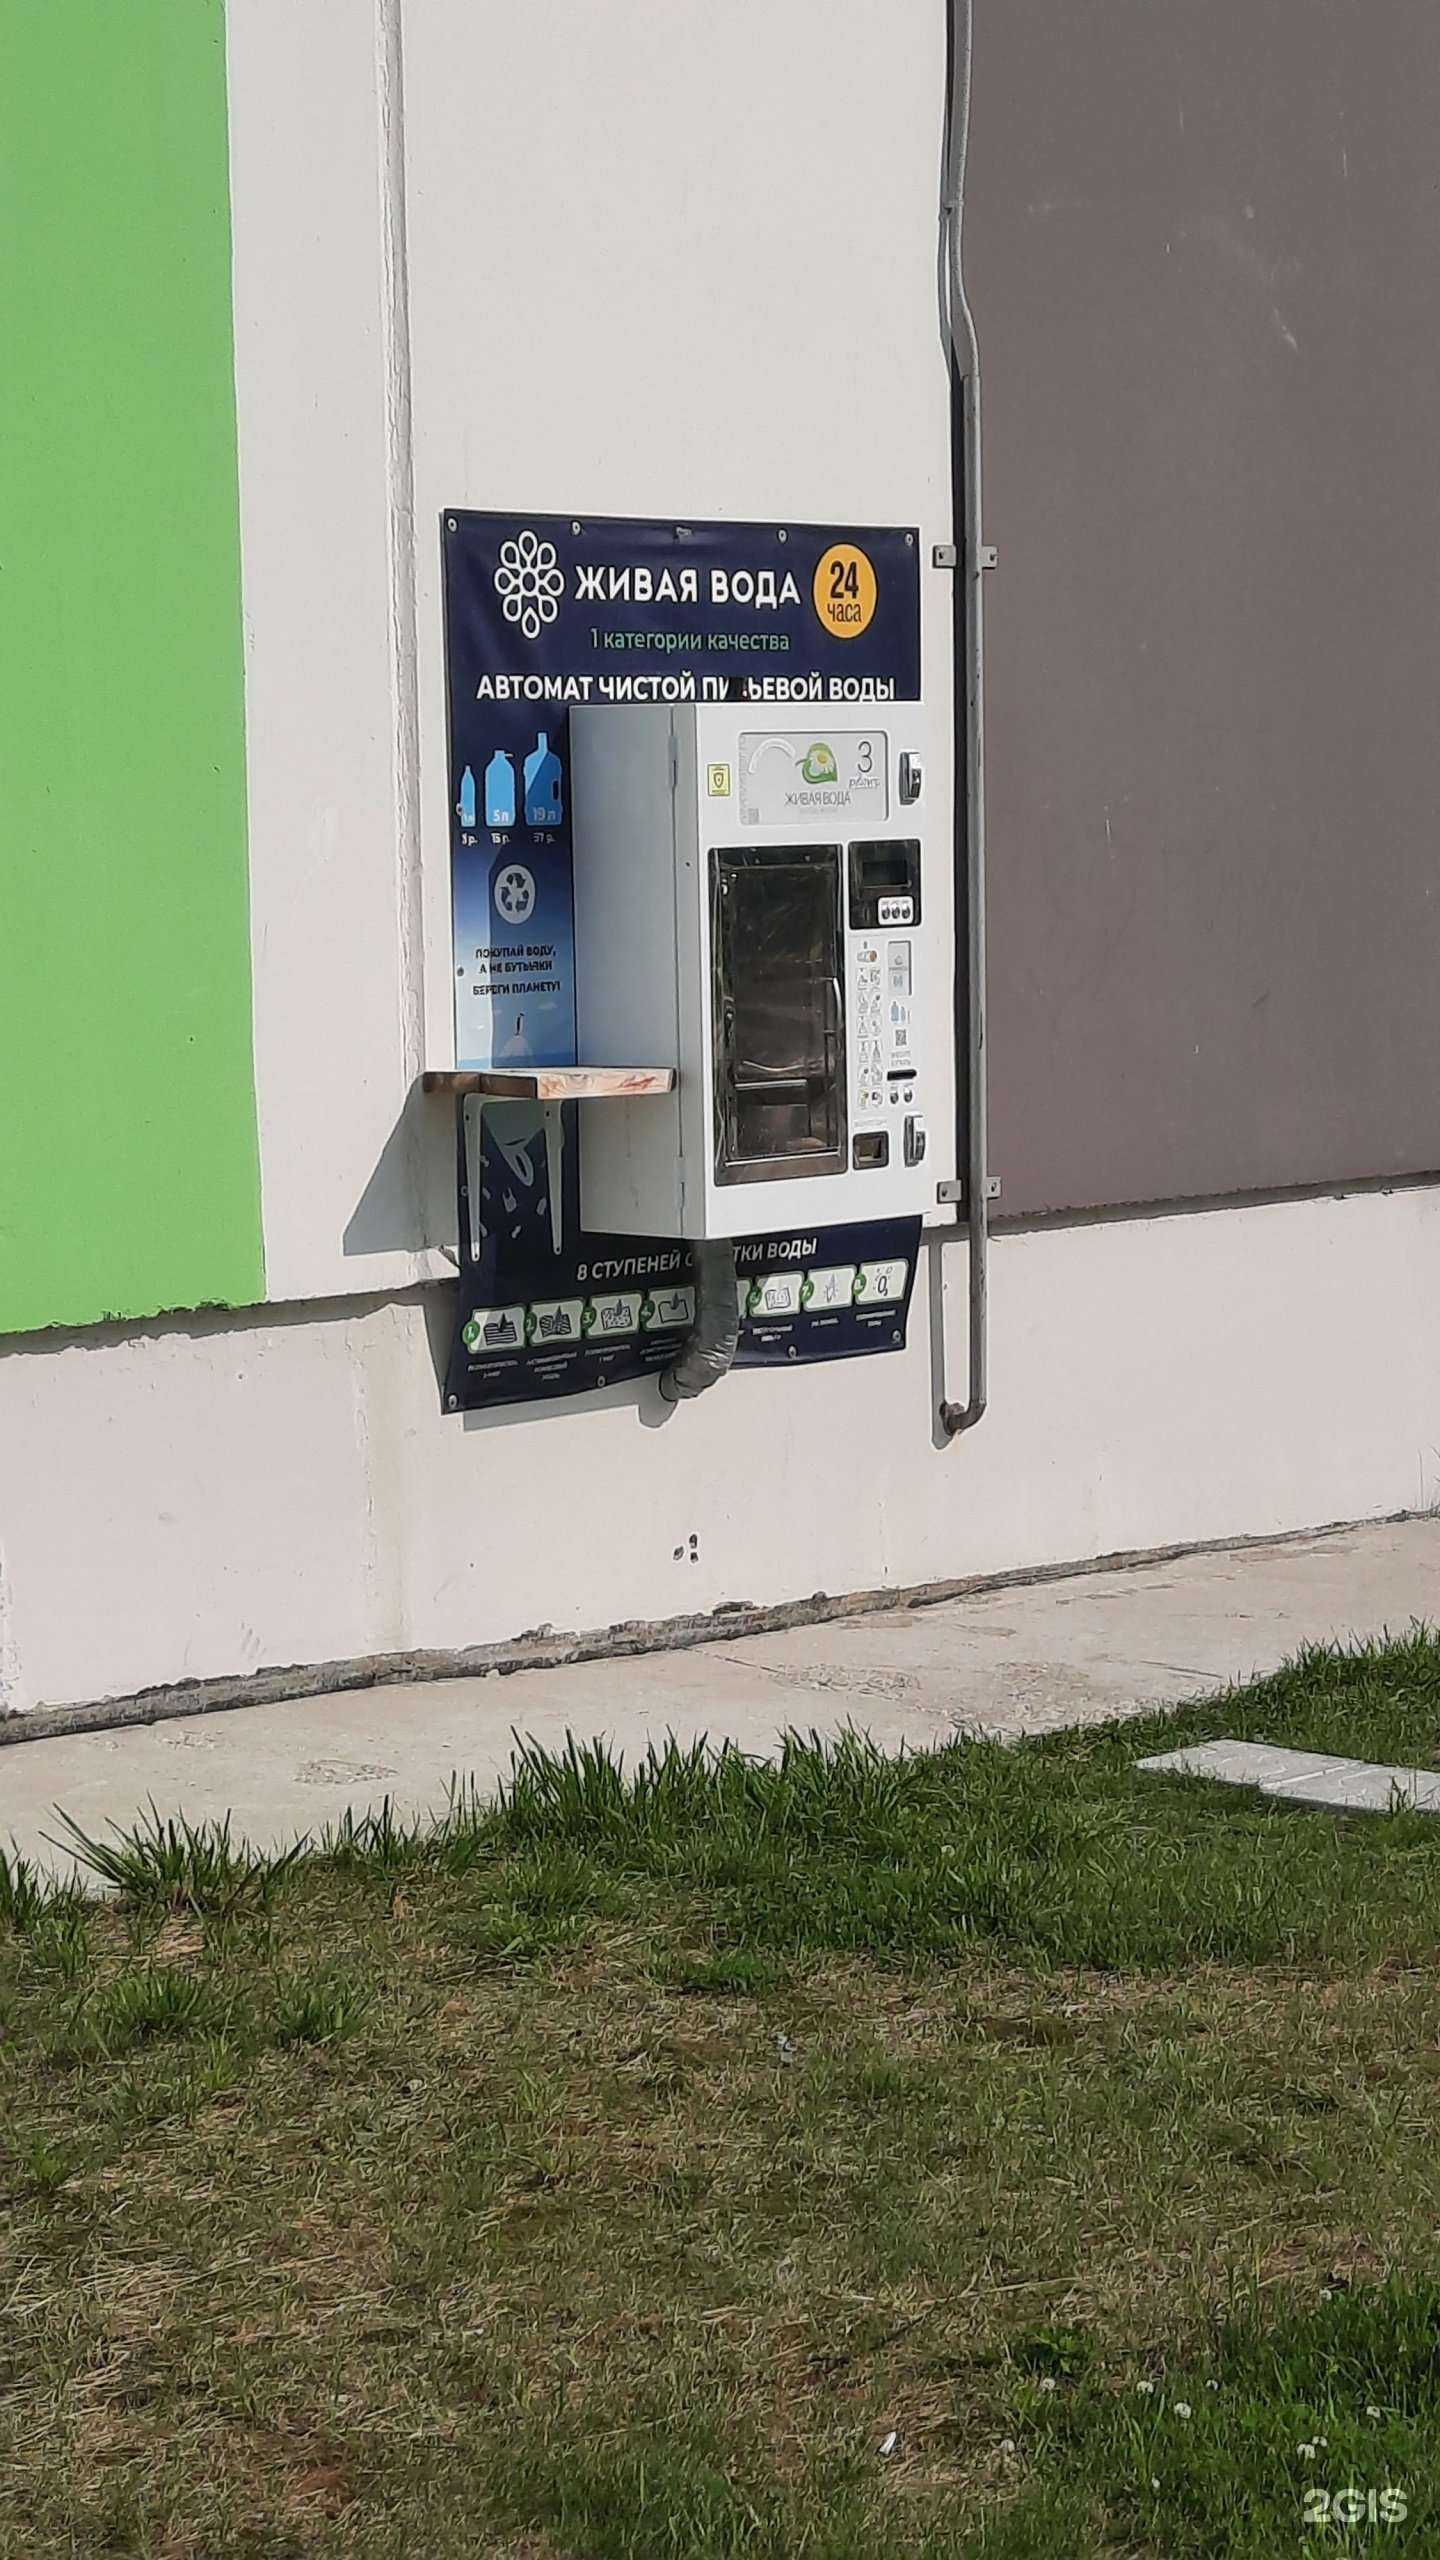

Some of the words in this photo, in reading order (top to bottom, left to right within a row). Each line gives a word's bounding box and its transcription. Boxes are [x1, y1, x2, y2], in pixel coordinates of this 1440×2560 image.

[575, 566, 698, 602] ЖИВАЯ
[711, 570, 801, 609] ВОДА
[829, 561, 860, 599] 24
[827, 602, 863, 624] часа
[591, 628, 599, 649] 1
[604, 632, 702, 655] категории
[708, 633, 790, 652] качества
[476, 675, 594, 701] АВТОМАТ
[599, 671, 695, 701] ЧИСТОЙ
[702, 671, 822, 701] ПИЬЕВОЙ
[829, 677, 896, 702] ВОДЫ
[857, 741, 873, 773] 3
[475, 945, 525, 958] ПОКУПАЙ
[479, 964, 487, 974] А
[473, 984, 510, 996] БЕРЕГИ
[577, 1264, 588, 1281] 8
[592, 1250, 681, 1279] СТУПЕНЕЙ
[767, 1238, 818, 1260] ВОДЫ
